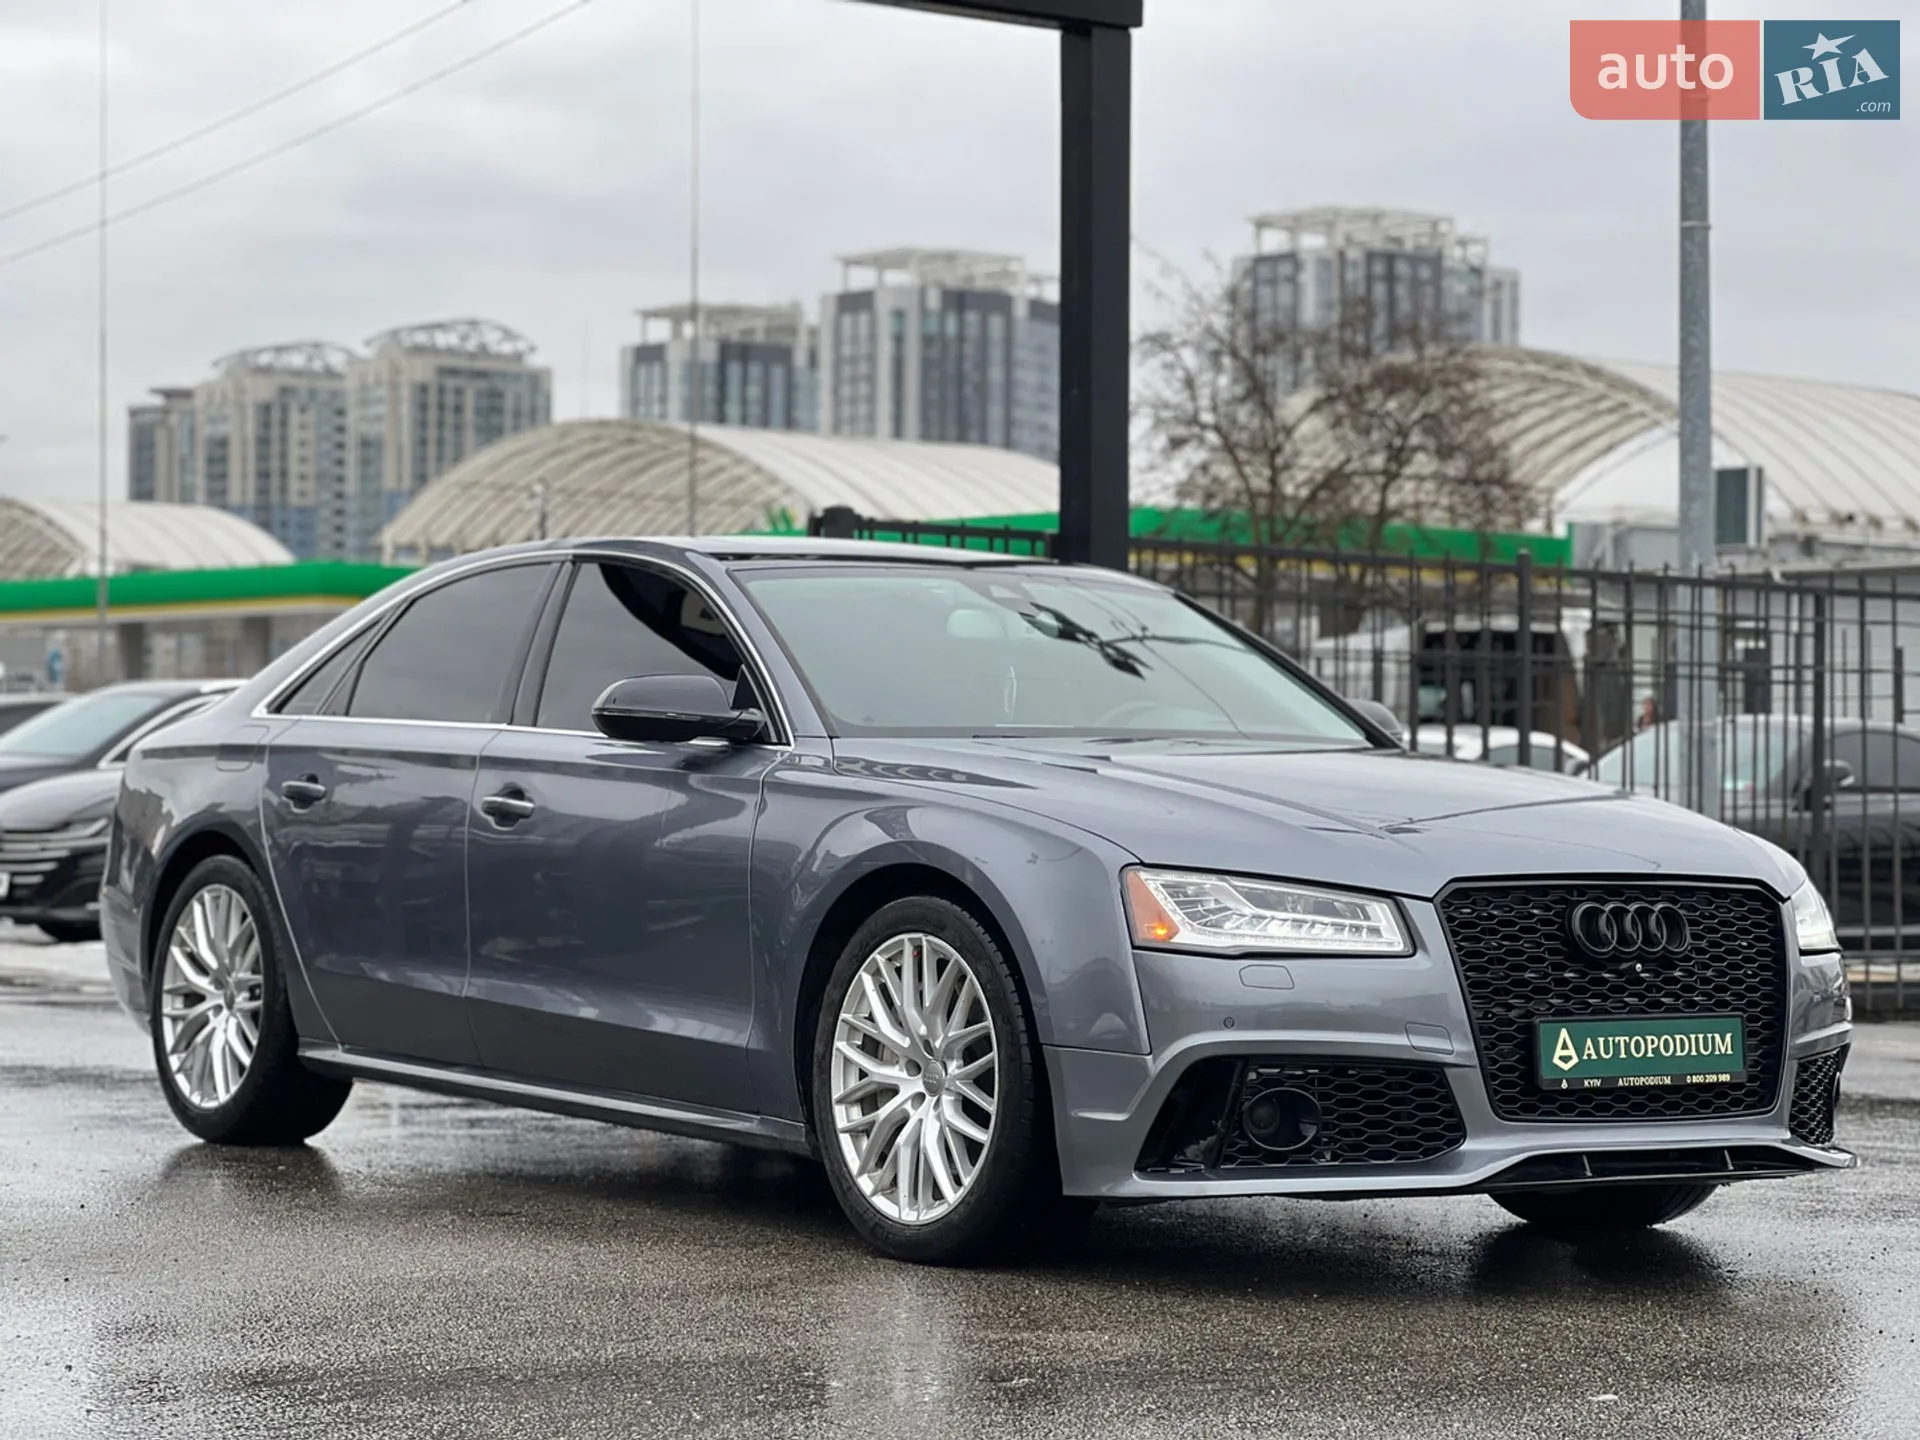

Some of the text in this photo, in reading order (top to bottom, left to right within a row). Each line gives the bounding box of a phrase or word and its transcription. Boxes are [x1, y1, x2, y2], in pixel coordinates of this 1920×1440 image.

[1582, 1033, 1734, 1060] AUTOPODIUM
[1583, 1078, 1602, 1088] KYIV
[1617, 1075, 1672, 1087] AUTOPODIUM
